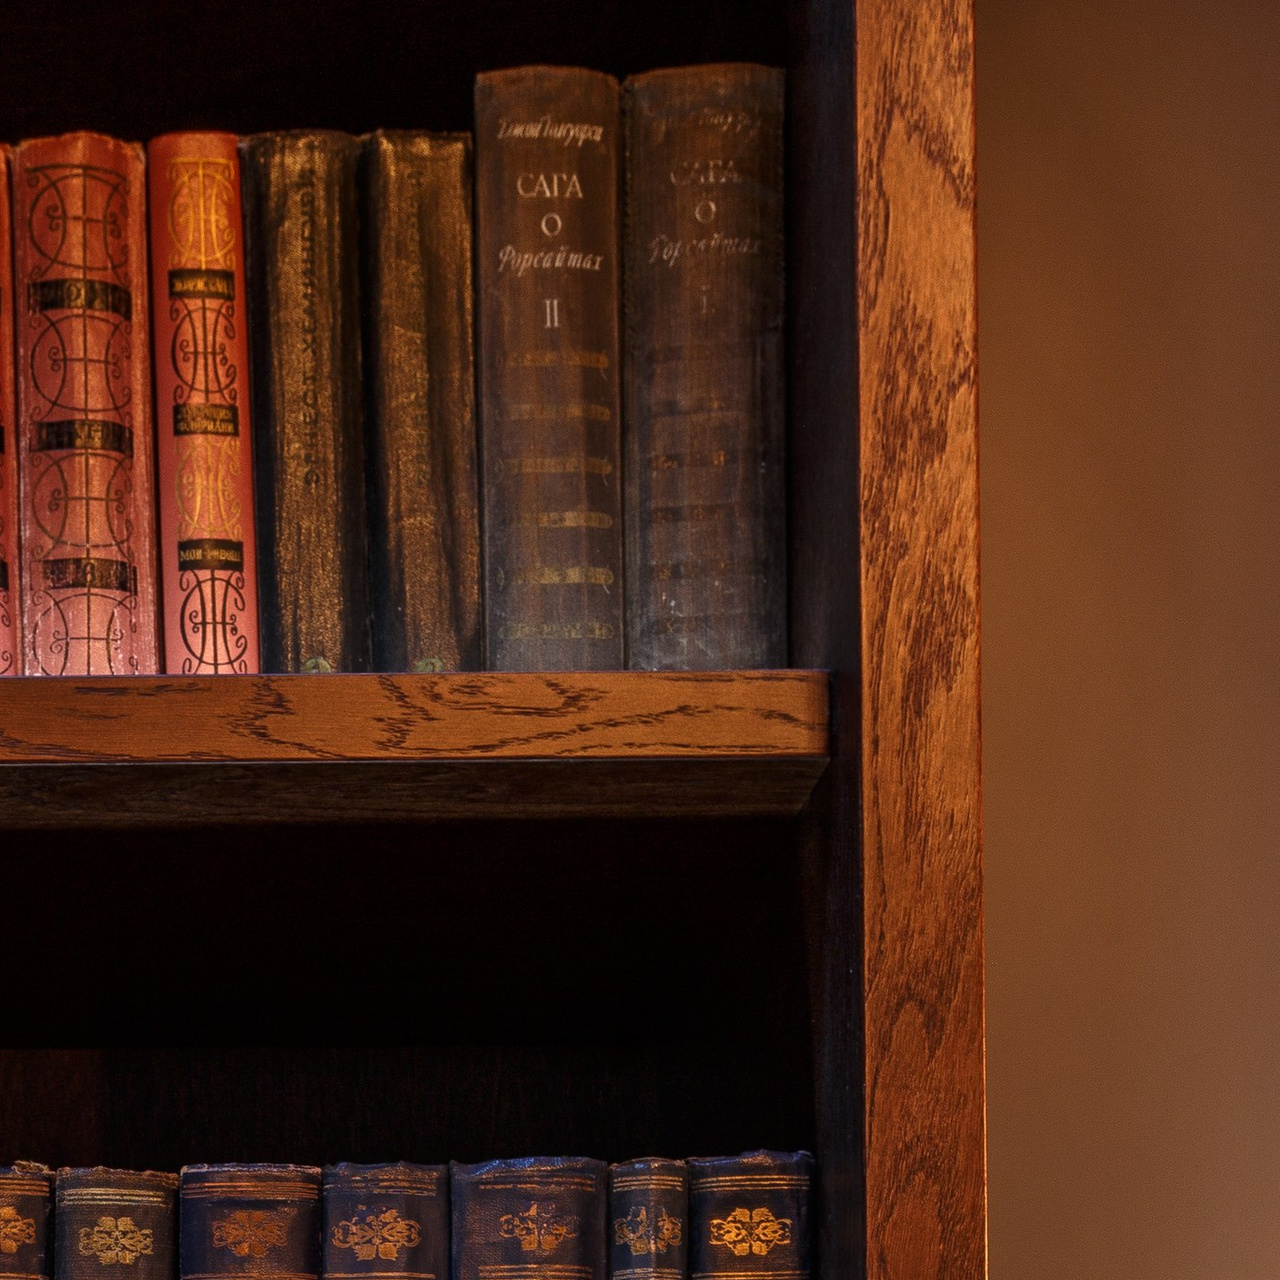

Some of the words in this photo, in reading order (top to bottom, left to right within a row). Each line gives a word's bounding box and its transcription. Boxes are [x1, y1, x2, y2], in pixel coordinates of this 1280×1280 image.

[517, 173, 583, 198] САГА
[541, 212, 562, 236] О
[695, 199, 717, 224] О
